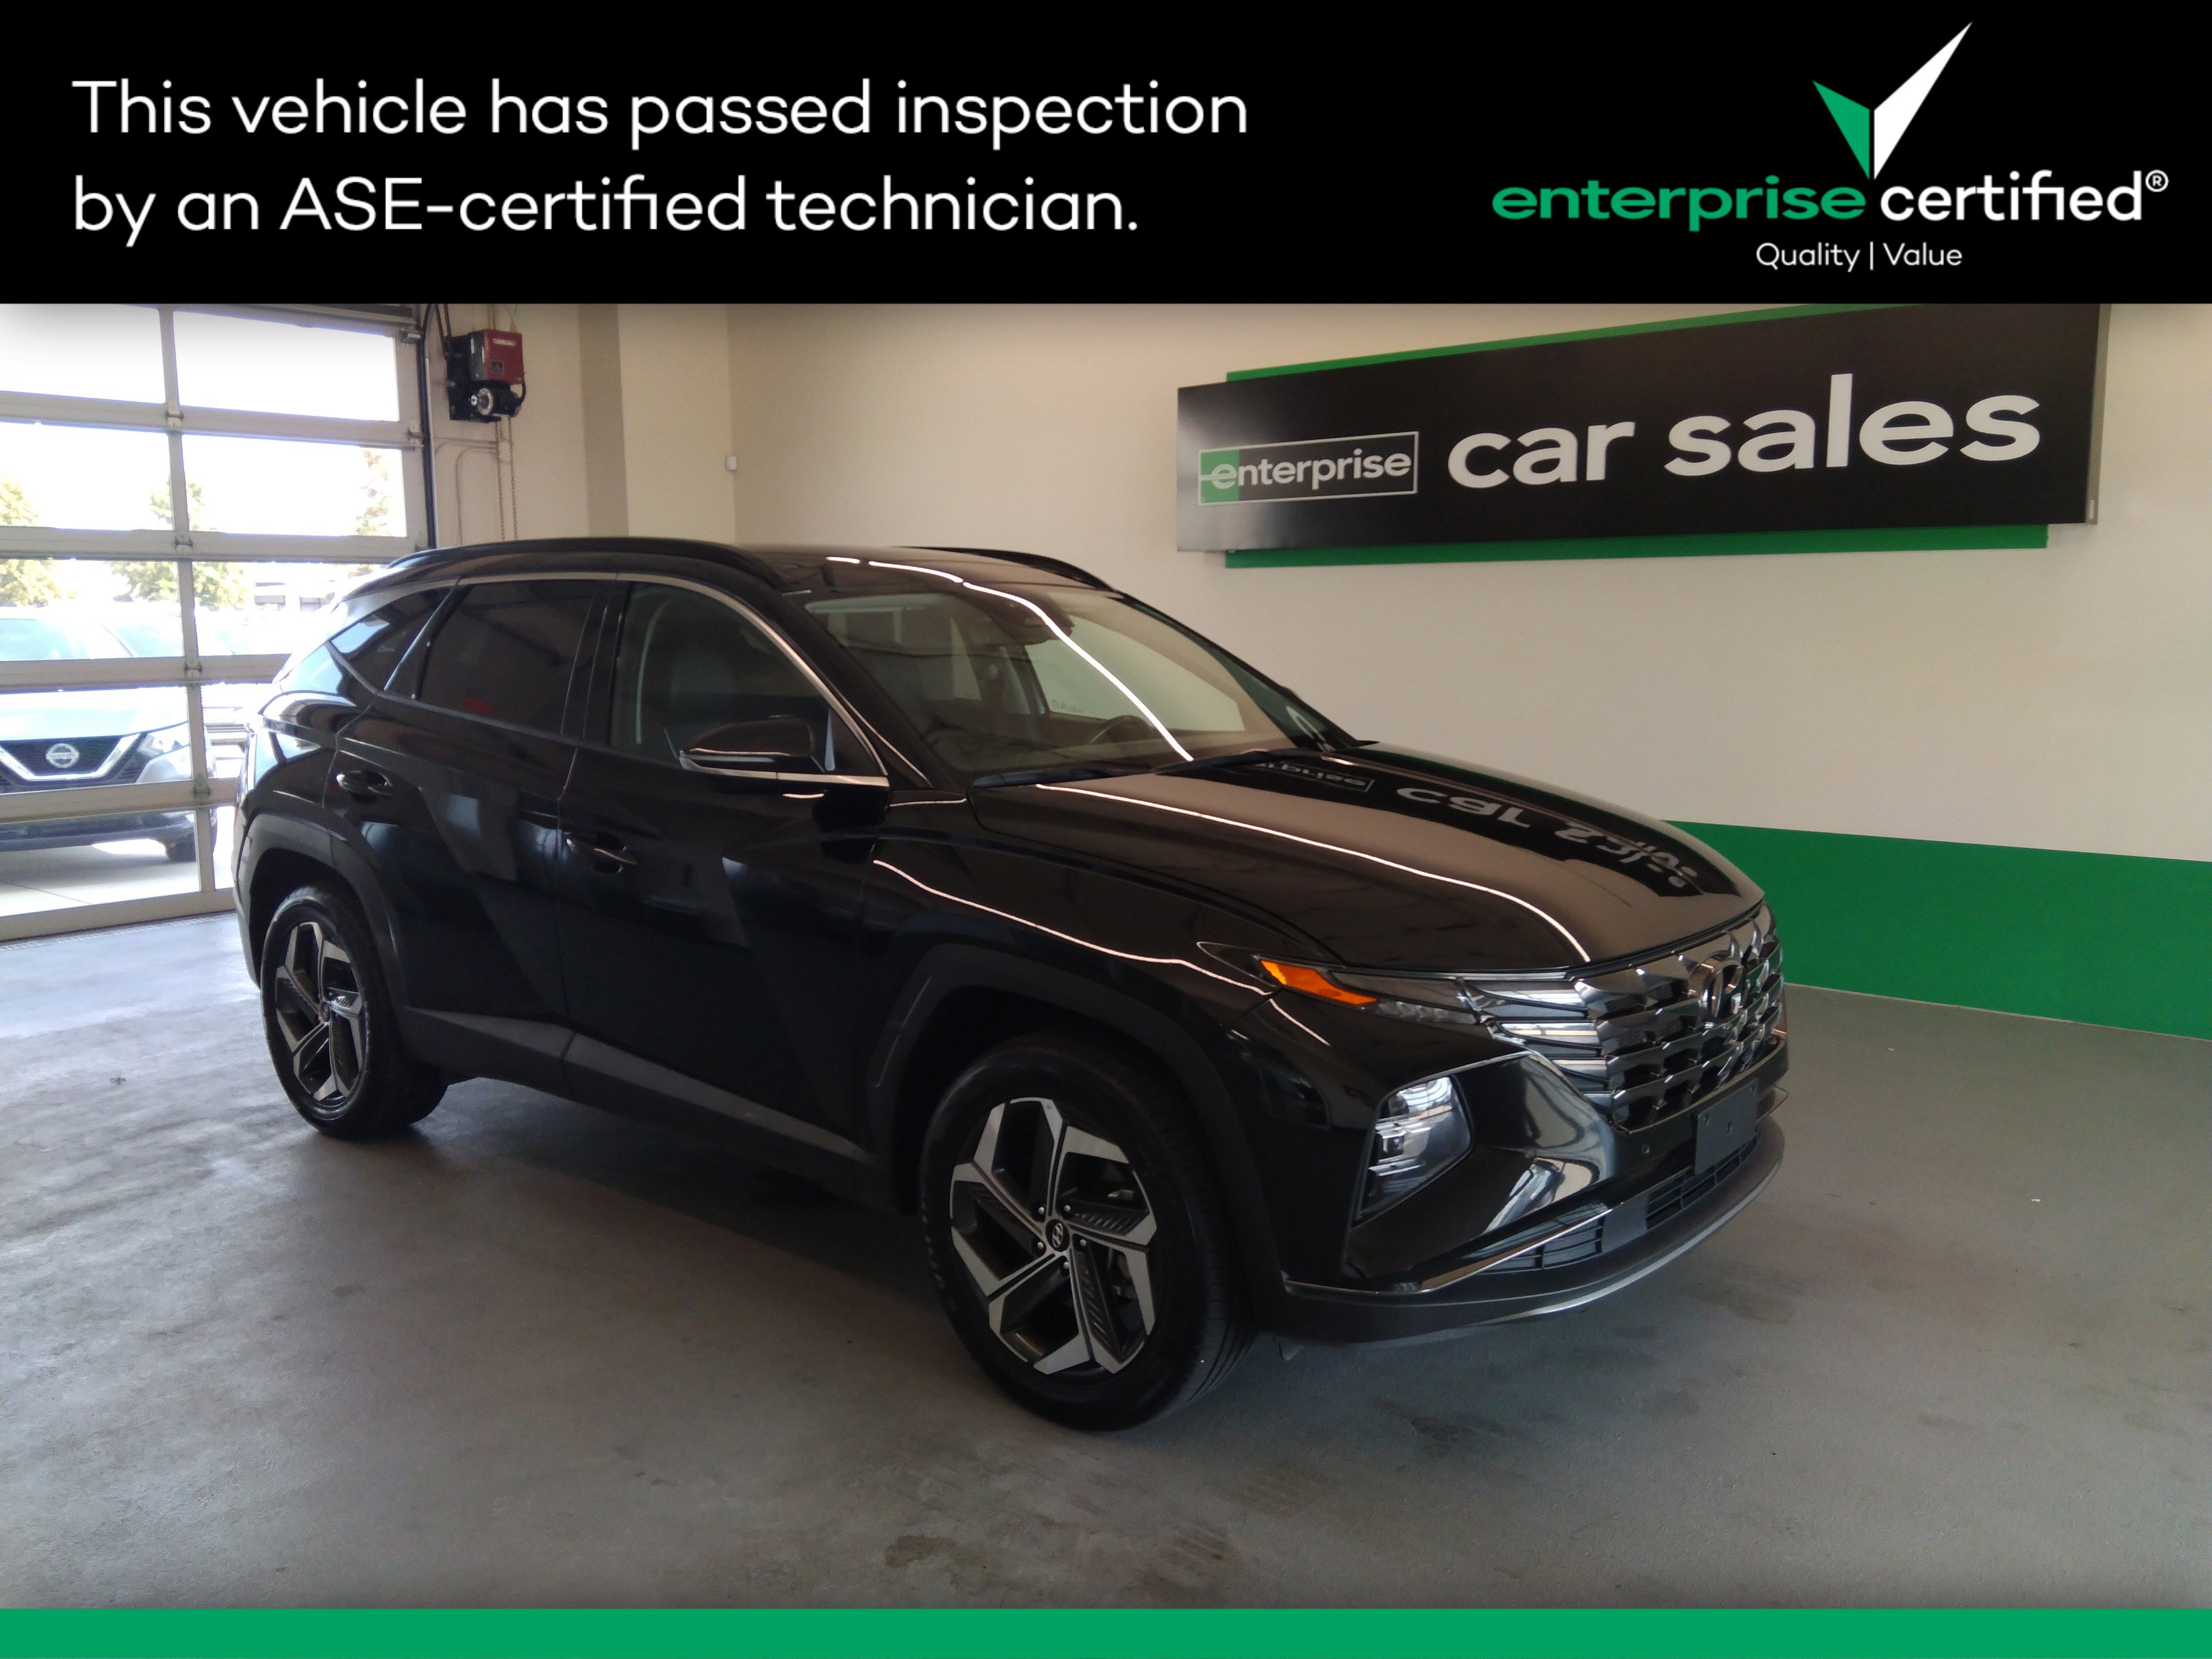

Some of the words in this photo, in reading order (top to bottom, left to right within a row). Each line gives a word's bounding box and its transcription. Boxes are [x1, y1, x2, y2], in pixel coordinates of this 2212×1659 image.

[1210, 448, 1412, 490] enterprise
[1447, 421, 1636, 489] car
[1664, 373, 2041, 477] sales
